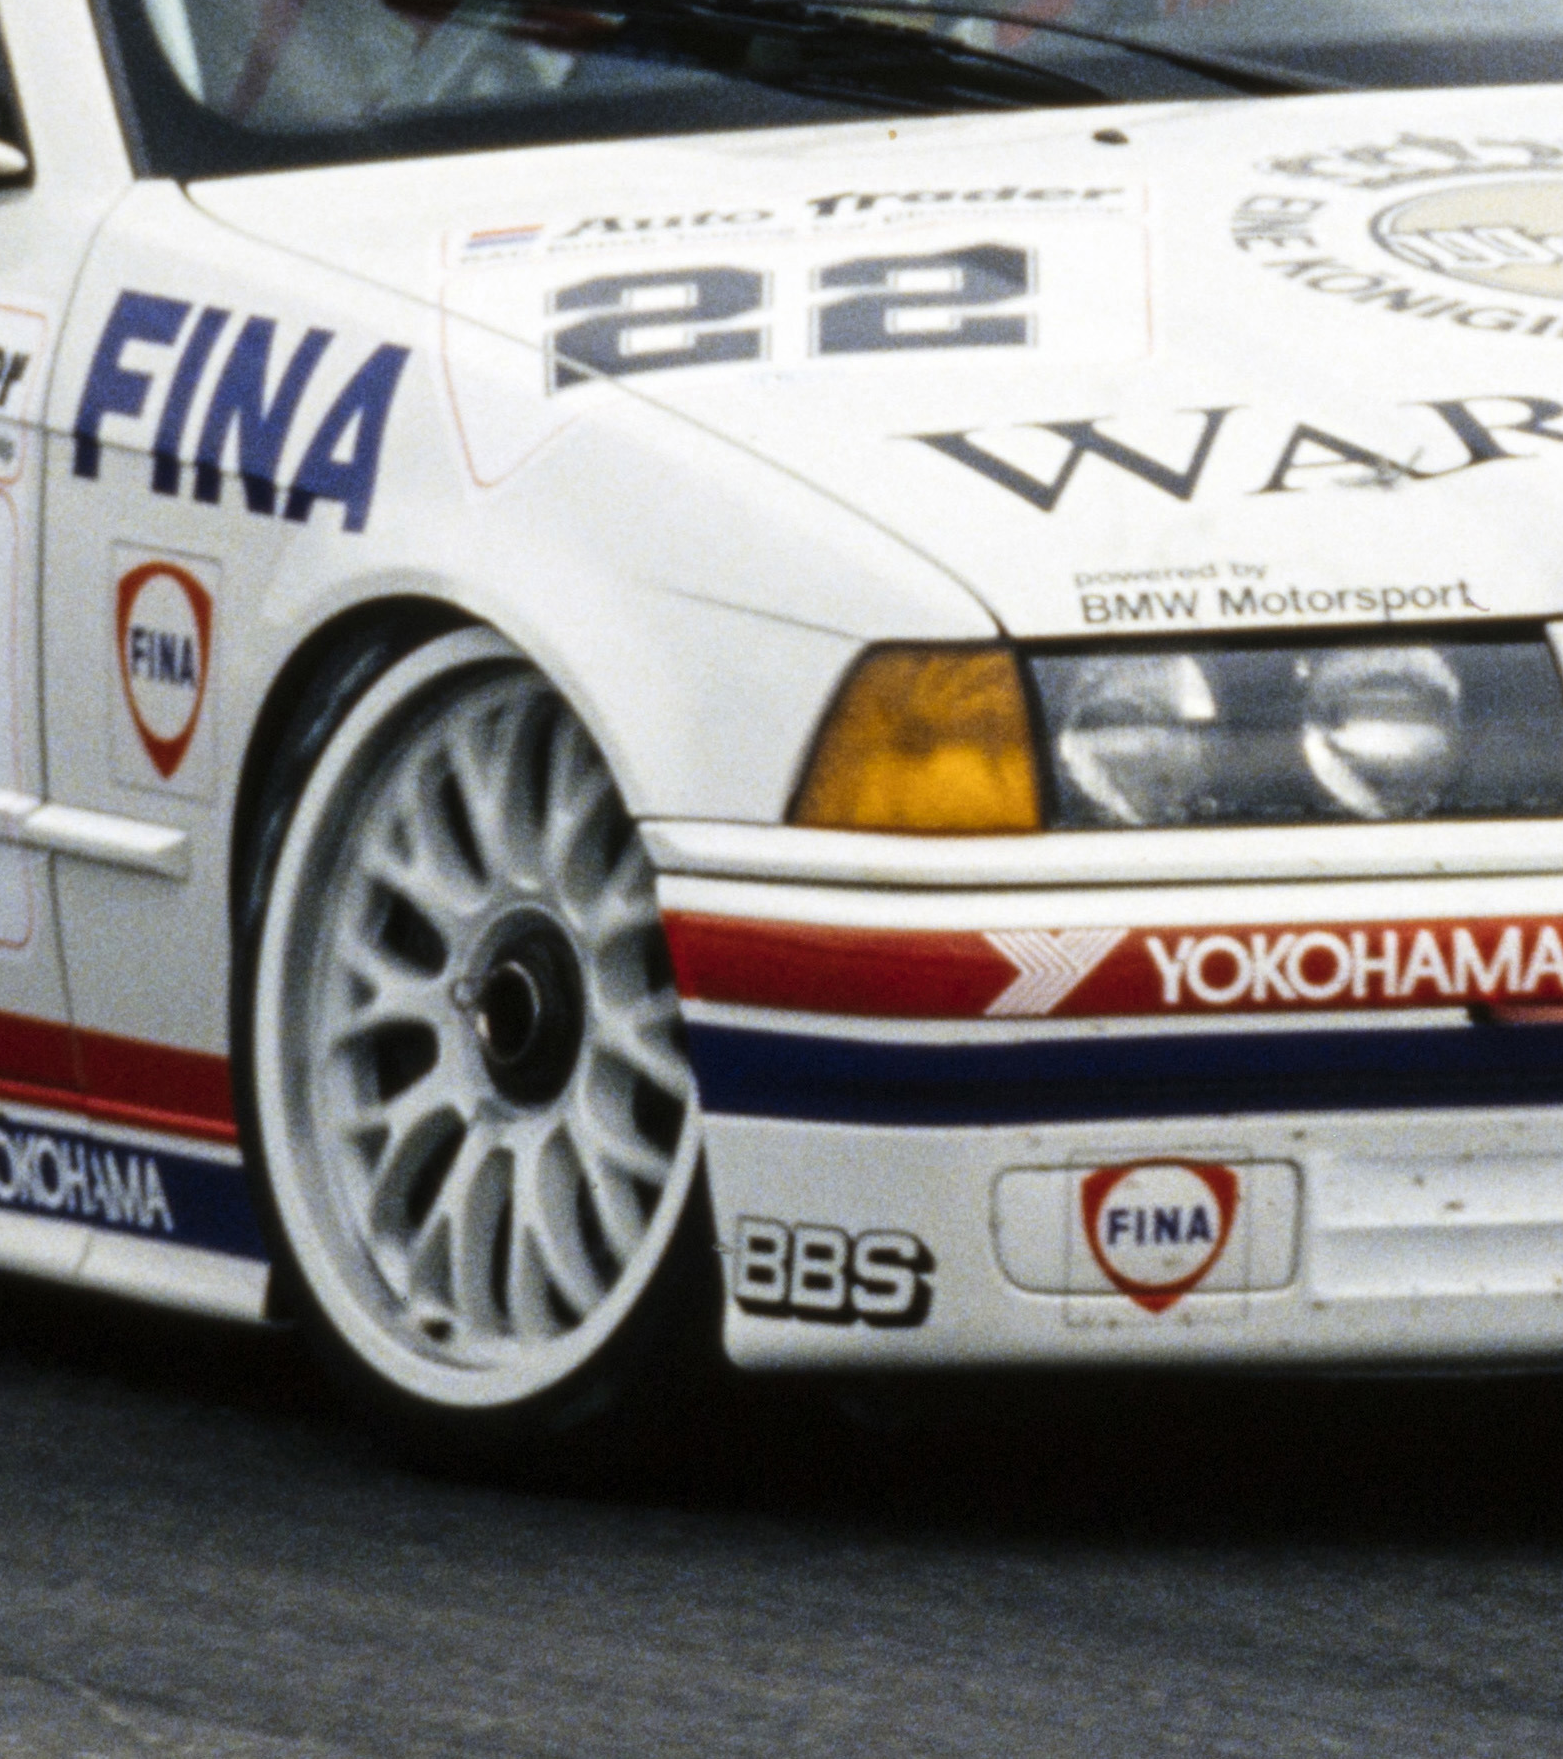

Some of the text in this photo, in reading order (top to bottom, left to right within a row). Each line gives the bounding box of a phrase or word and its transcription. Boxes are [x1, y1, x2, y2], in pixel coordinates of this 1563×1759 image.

[559, 185, 1127, 240] Auto Trader
[543, 239, 1040, 397] 22
[72, 288, 413, 534] FINA
[1074, 560, 1268, 590] powered by
[1080, 579, 1474, 624] BMW Motorsport
[129, 627, 199, 691] FINA
[1105, 1203, 1215, 1249] FINA
[734, 1213, 937, 1329] BBS
